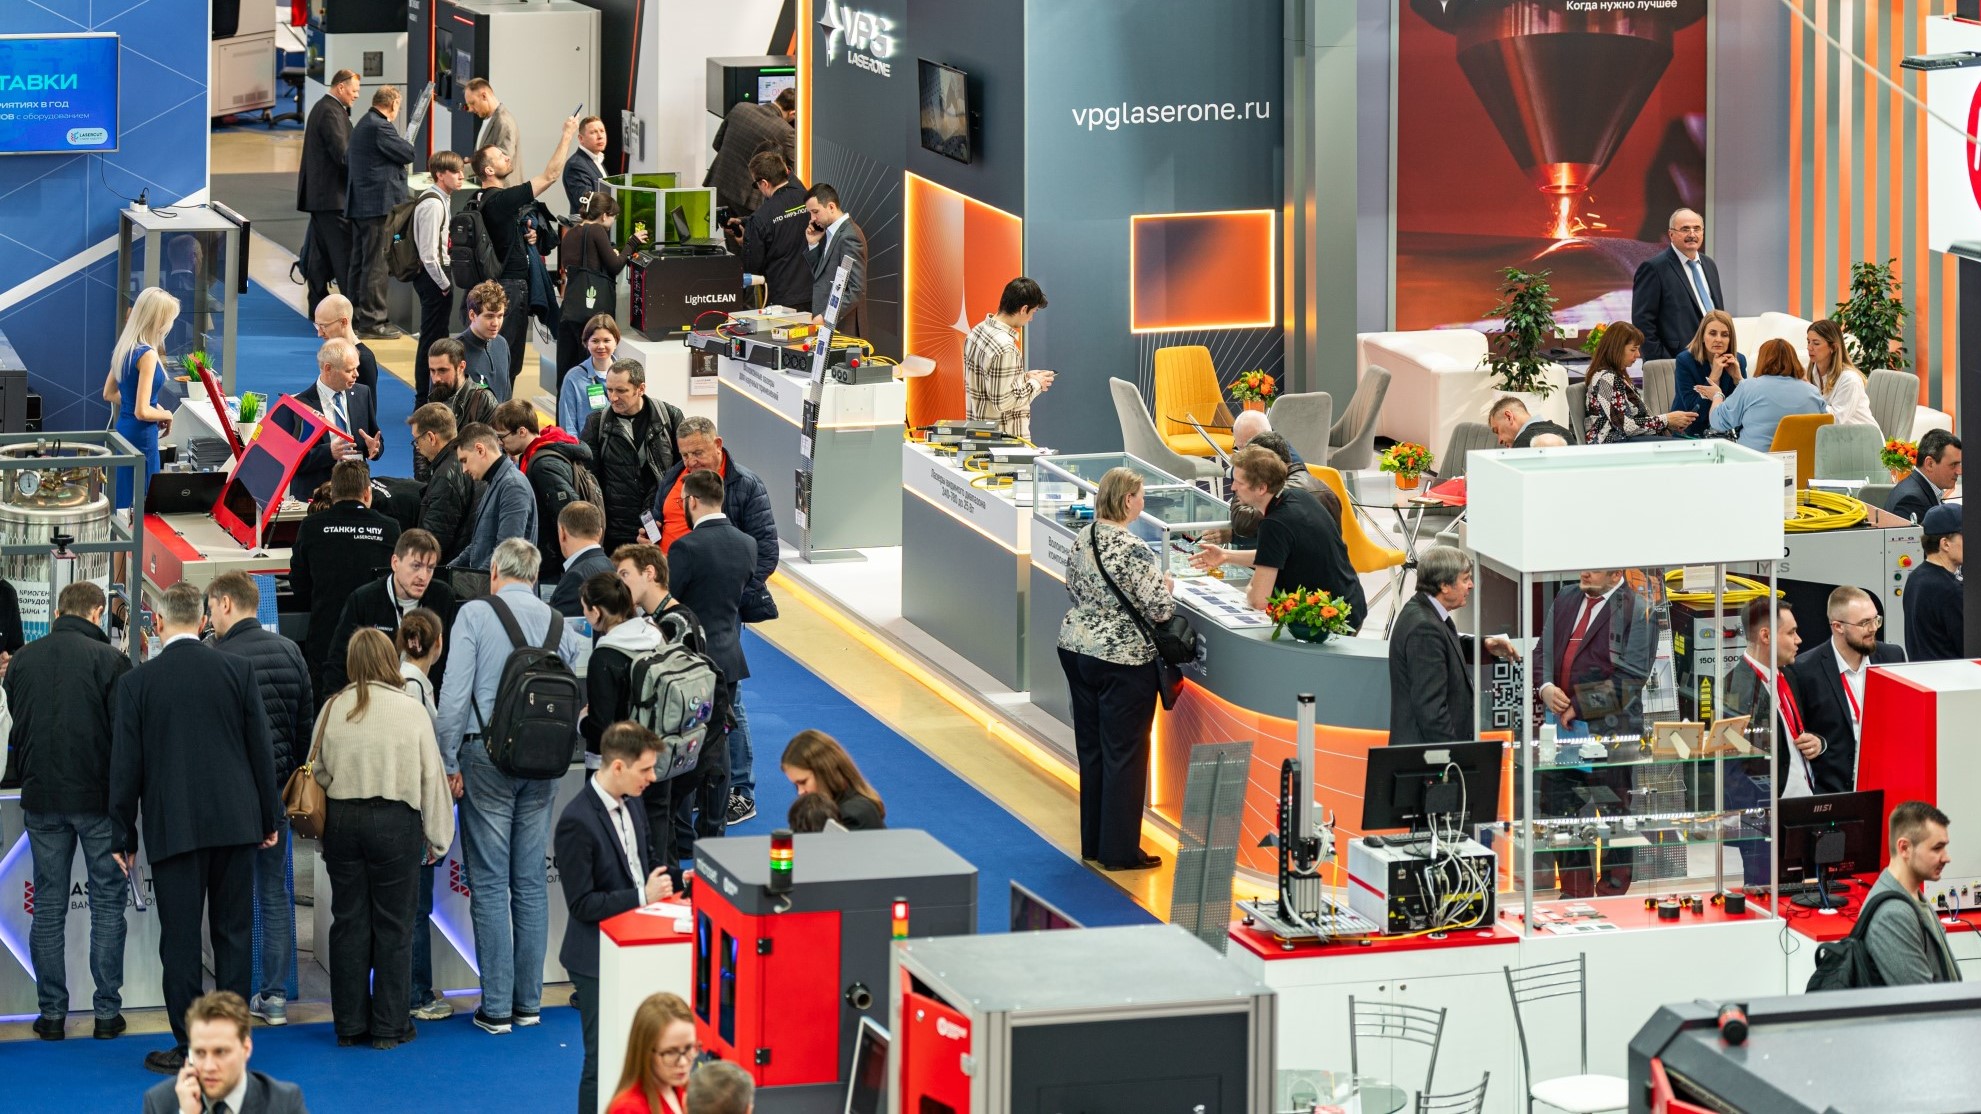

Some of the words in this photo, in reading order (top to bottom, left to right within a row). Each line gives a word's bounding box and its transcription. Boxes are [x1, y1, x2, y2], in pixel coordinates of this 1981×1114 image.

[1566, 0, 1598, 11] Когда
[1600, 0, 1635, 10] нужно
[1637, 0, 1677, 9] лучшее
[840, 6, 890, 58] VPG
[848, 50, 891, 77] LASERONE
[23, 113, 90, 121] оборудованием
[1071, 101, 1270, 131] vpglaserone.ru
[685, 294, 736, 305] LightCLEAN
[930, 468, 946, 485] Лазеры
[965, 490, 986, 510] диапазона
[366, 527, 382, 535] ЧПУ
[1760, 562, 1790, 573] YS
[1813, 804, 1832, 813] MSI
